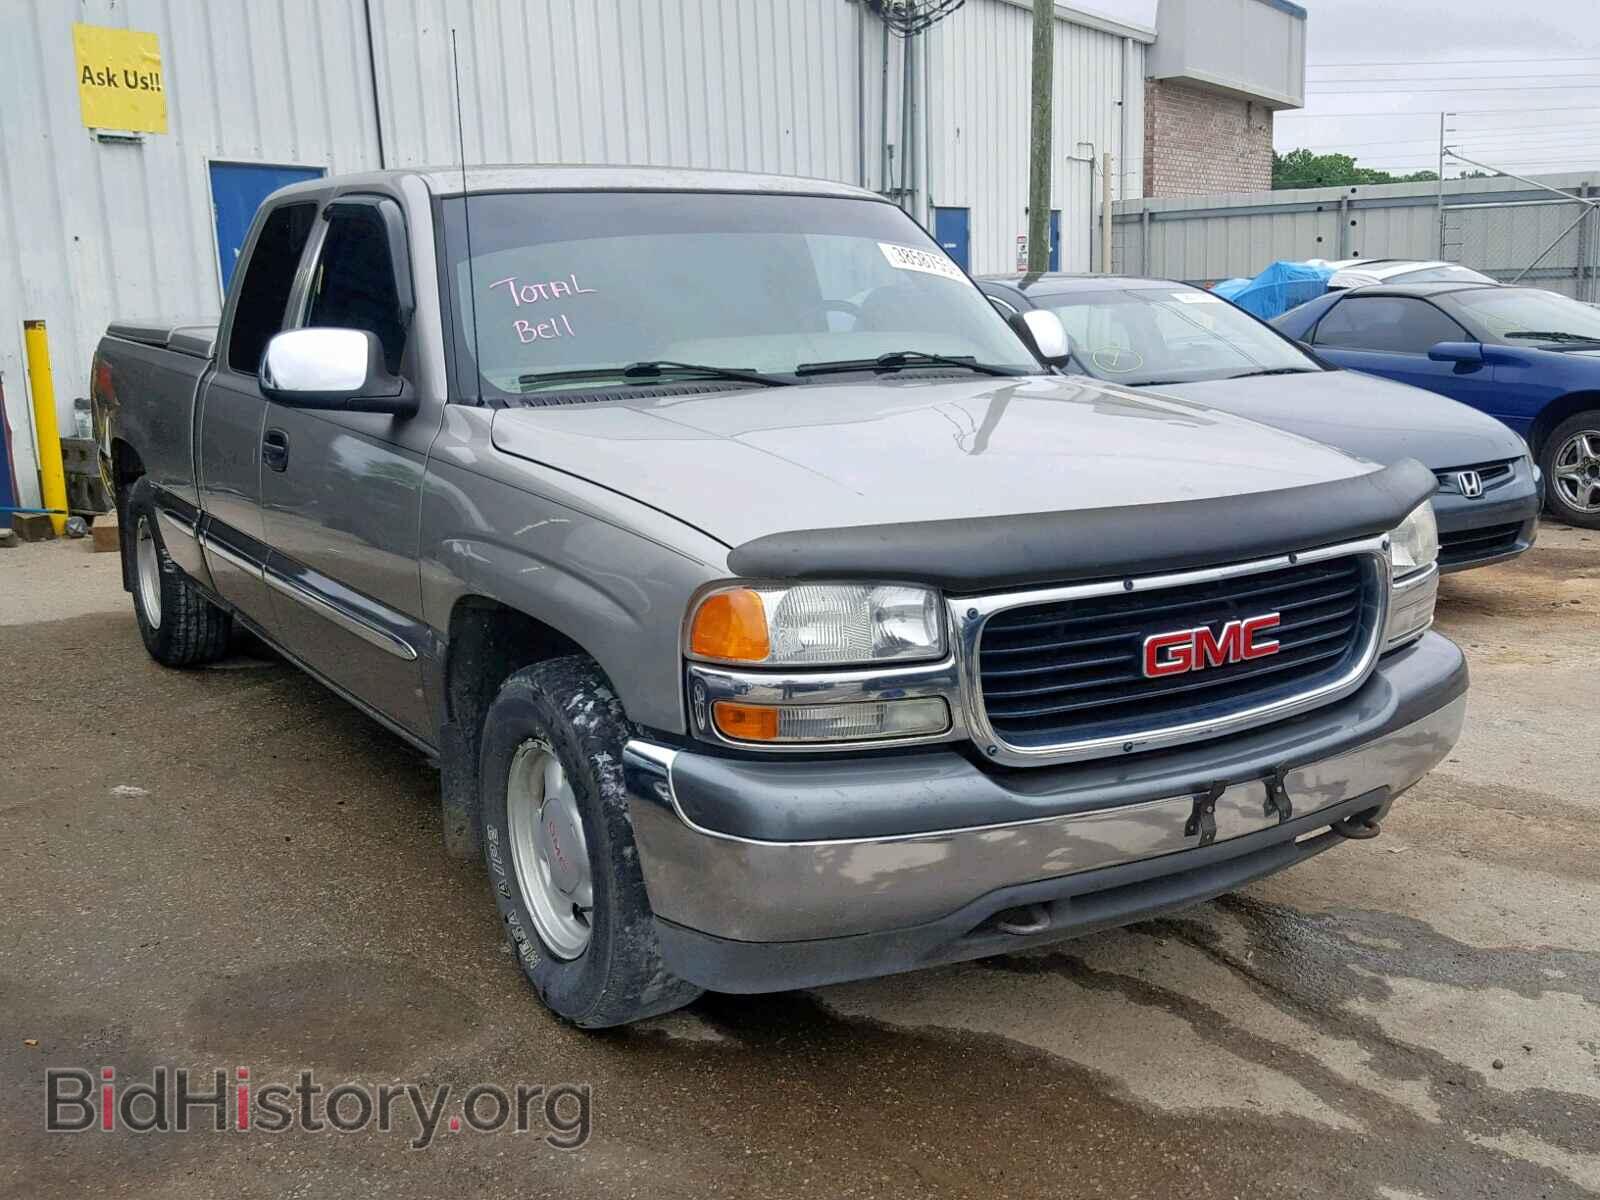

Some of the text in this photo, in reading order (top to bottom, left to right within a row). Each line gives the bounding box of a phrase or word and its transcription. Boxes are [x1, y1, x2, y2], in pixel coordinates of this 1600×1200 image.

[81, 65, 161, 92] Ask Us!!
[513, 314, 575, 343] Bell
[1143, 612, 1280, 678] GMC
